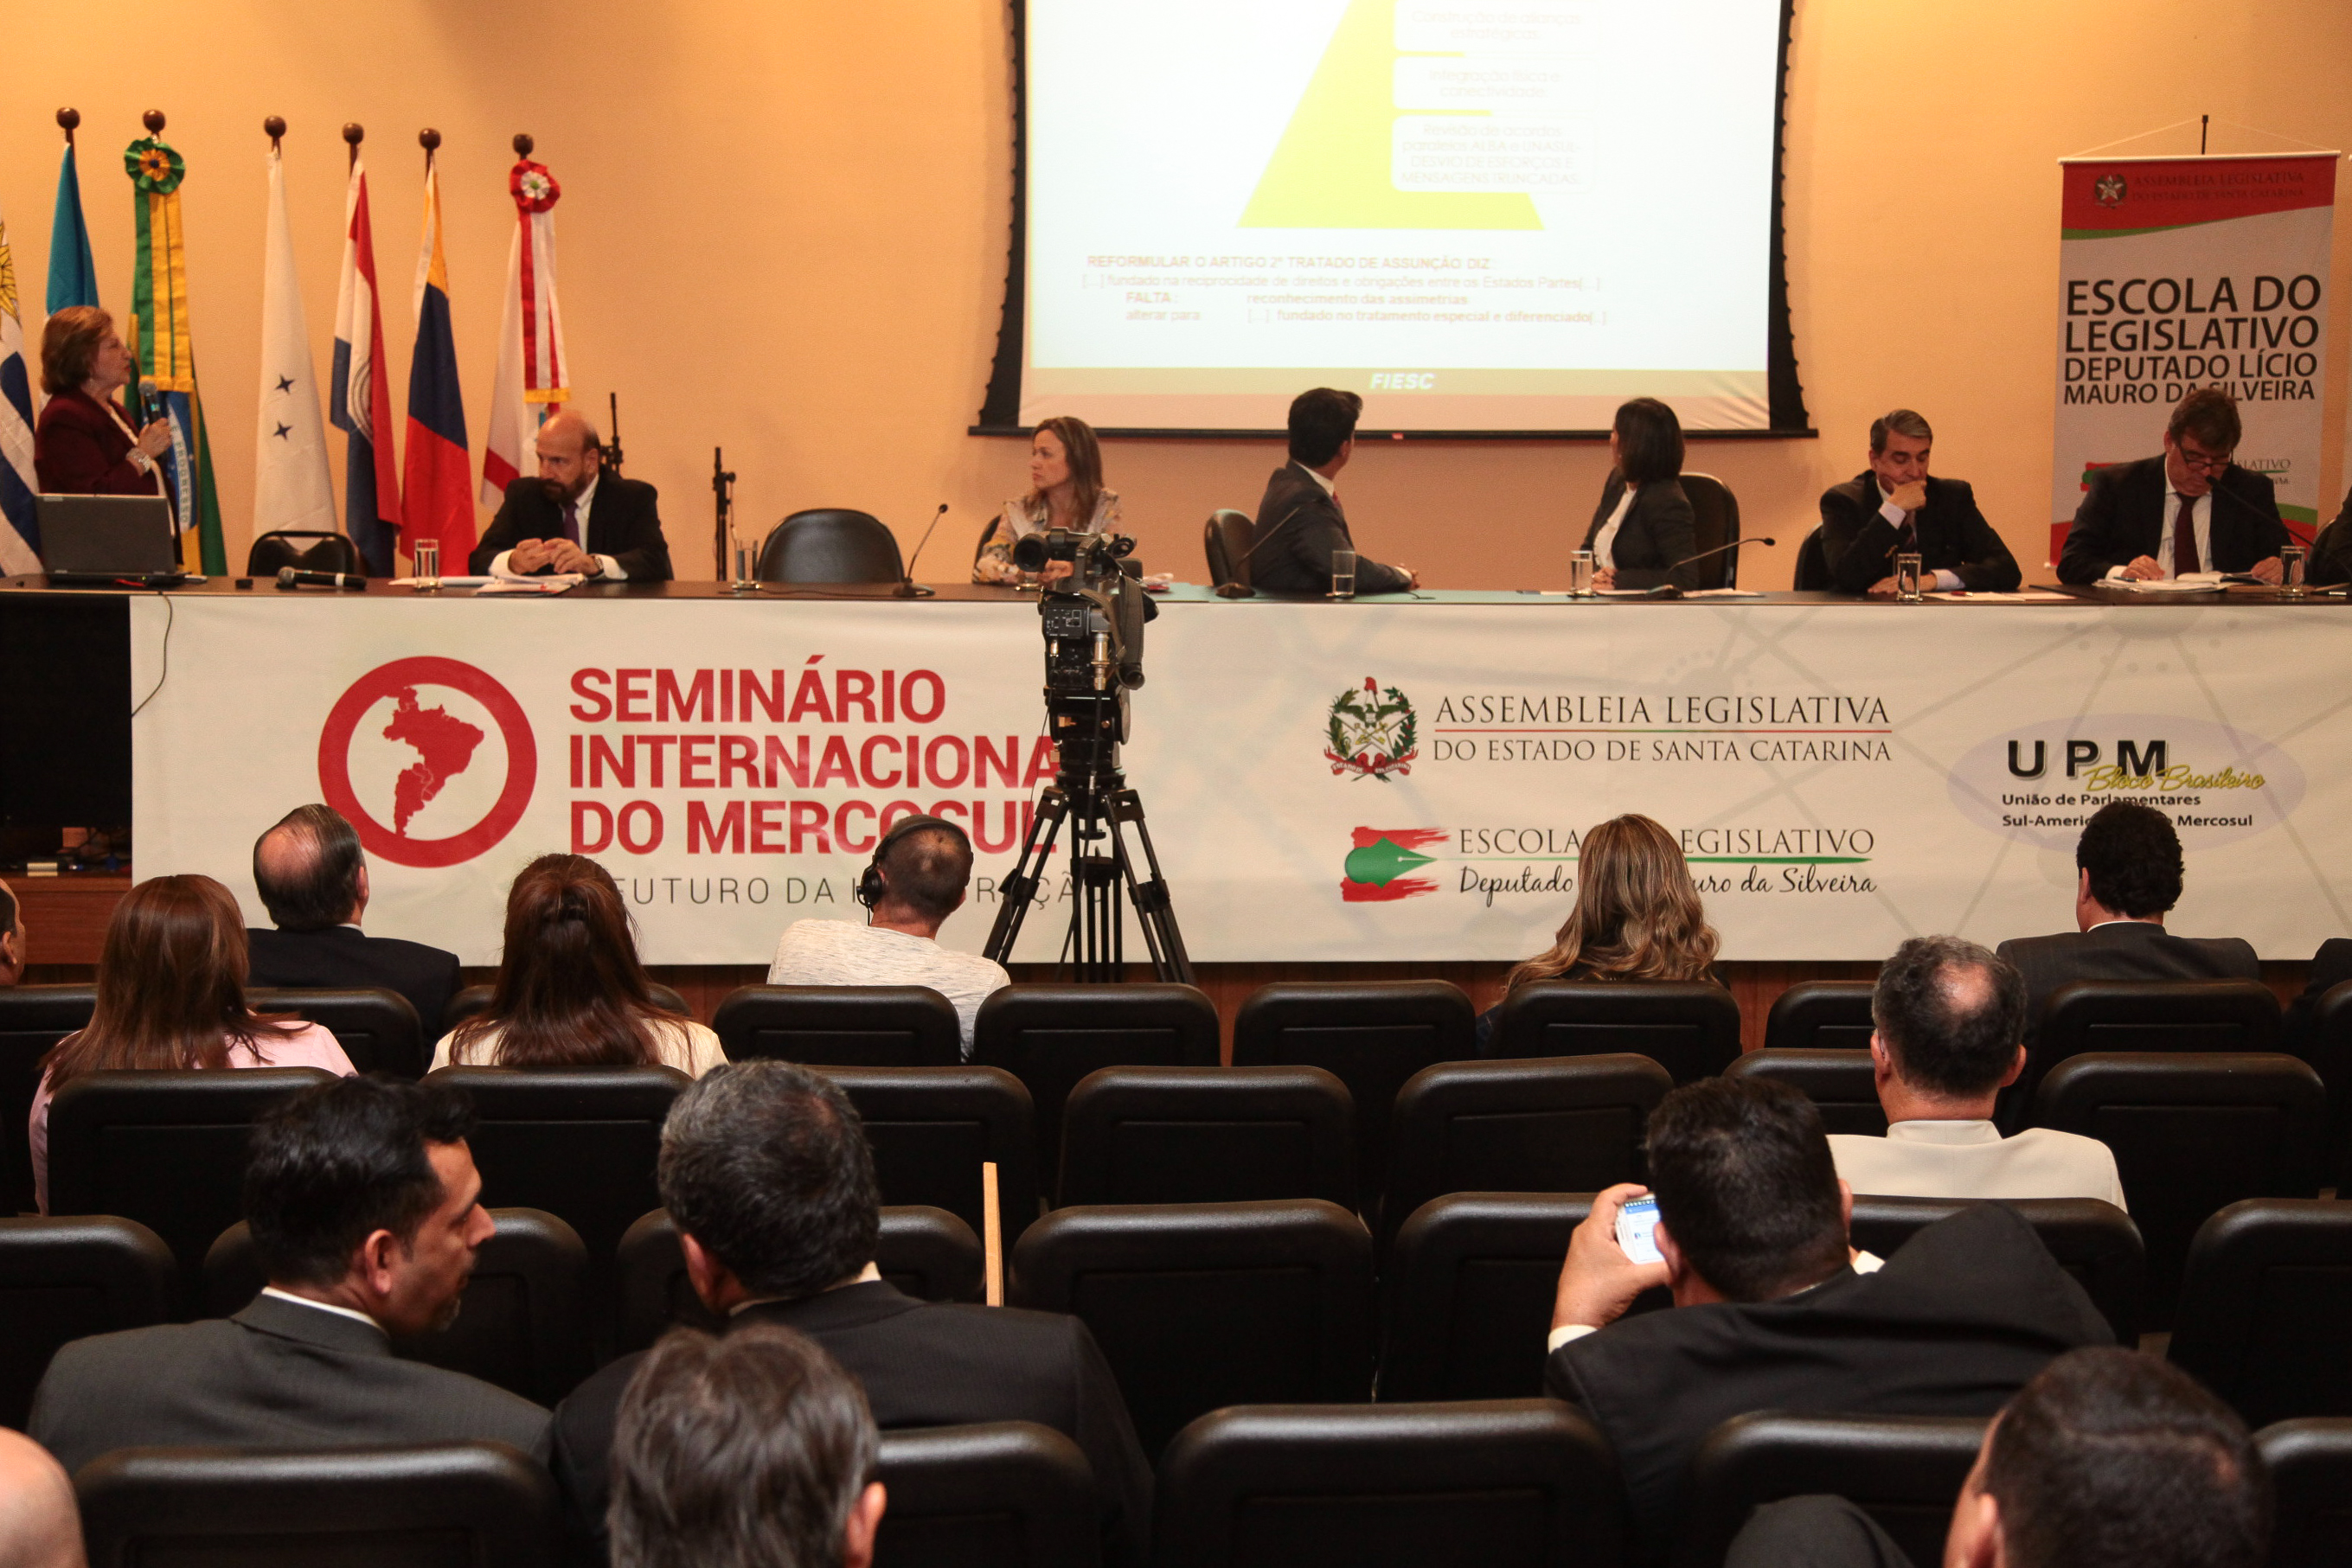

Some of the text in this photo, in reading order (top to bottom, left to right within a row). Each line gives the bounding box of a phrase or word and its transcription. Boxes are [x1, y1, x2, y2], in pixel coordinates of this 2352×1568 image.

[1411, 155, 1464, 168] DESVIO
[1465, 156, 1485, 168] DE
[1086, 256, 1189, 267] REFORMULAR
[1195, 256, 1206, 268] O
[1209, 256, 1266, 268] ARTIGO
[1287, 256, 1355, 268] TRATADO
[1359, 257, 1377, 269] DE
[1381, 254, 1462, 272] ASSUNÇÃO
[1108, 274, 1159, 286] fundado
[1163, 277, 1179, 286] na
[1182, 275, 1268, 289] reciprocidade
[1272, 275, 1288, 286] de
[1292, 275, 1337, 286] direitos
[1342, 278, 1350, 287] e
[1354, 275, 1424, 290] obrigações
[1427, 277, 1460, 287] entre
[1464, 278, 1478, 287] os
[1483, 276, 1534, 288] Estados
[1246, 293, 1357, 304] reconhecimento
[1361, 293, 1385, 304] das
[1388, 294, 1468, 304] assimetrias
[2067, 275, 2321, 317] ESCOLA DO
[1170, 311, 1201, 323] para
[1277, 309, 1333, 321] fundado
[1336, 312, 1353, 321] no
[1355, 310, 1431, 322] tratamento
[1433, 310, 1489, 323] especial
[1492, 313, 1501, 322] e
[2066, 316, 2320, 354] LEGISLATIVO
[2064, 349, 2318, 382] DEPUTADO LÍCIO
[1369, 372, 1435, 390] FIESC
[2064, 382, 2158, 405] MAURO
[2210, 379, 2316, 402] LVEIRA
[2236, 458, 2291, 470] LATIVO
[569, 655, 945, 725] SEMINÁRIO
[1435, 695, 1891, 725] ASSEMBLEIA LEGISLATIVA
[569, 734, 1061, 790] INTERNACIONA
[1432, 739, 1893, 763] DO ESTADO DE SANTA CATARINA
[2082, 765, 2266, 792] Bloco Brasileiro
[2002, 793, 2201, 806] União de Parlamentares
[569, 800, 664, 855] DO
[2002, 815, 2092, 828] Sul-Ameri
[2177, 814, 2253, 827] Mercosul
[1459, 827, 1875, 855] ESCOLA EGISLATIVO
[787, 877, 835, 905] DA
[1459, 865, 1878, 908] Deputado uro da Silveira
